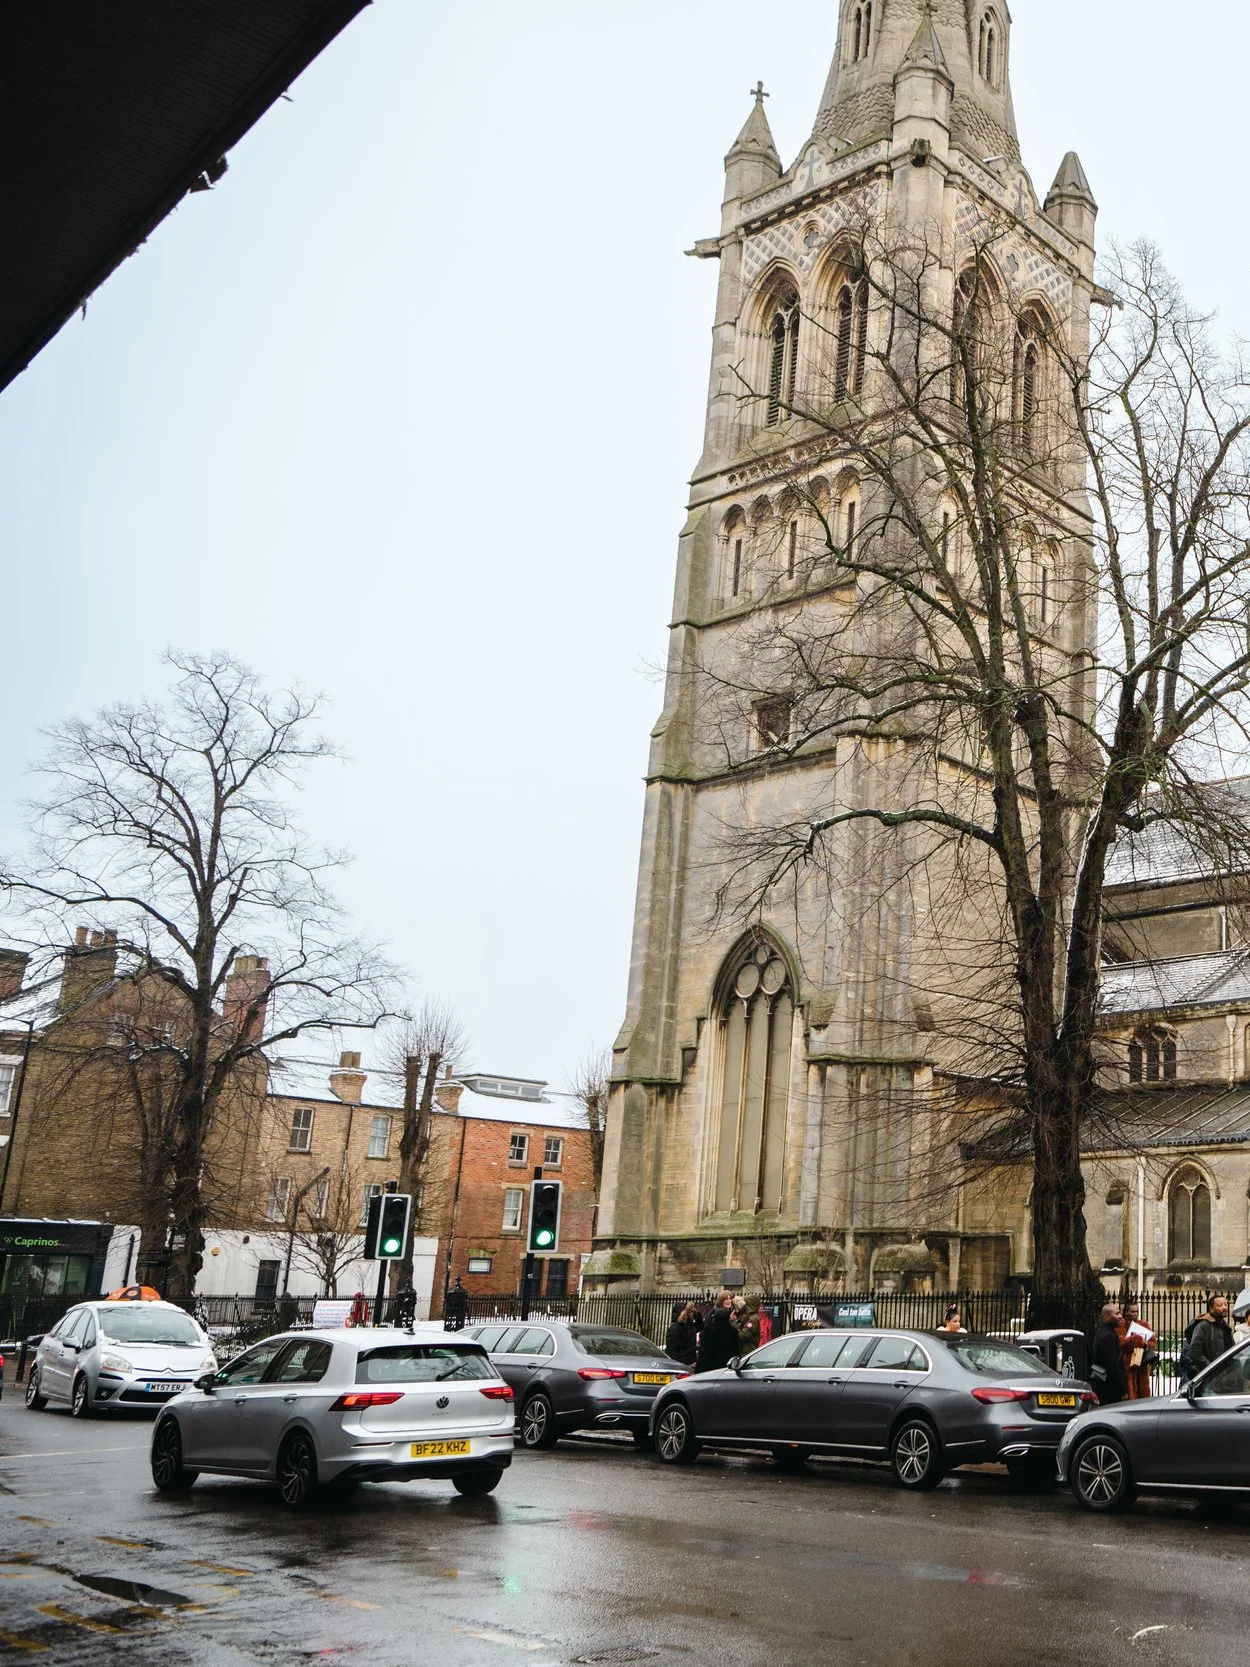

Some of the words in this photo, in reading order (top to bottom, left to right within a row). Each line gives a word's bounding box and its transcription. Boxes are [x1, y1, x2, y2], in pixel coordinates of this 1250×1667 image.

[14, 1236, 59, 1248] Caprinos
[794, 1307, 818, 1321] OPERA
[415, 1443, 444, 1455] BF22
[446, 1441, 467, 1453] KHZ
